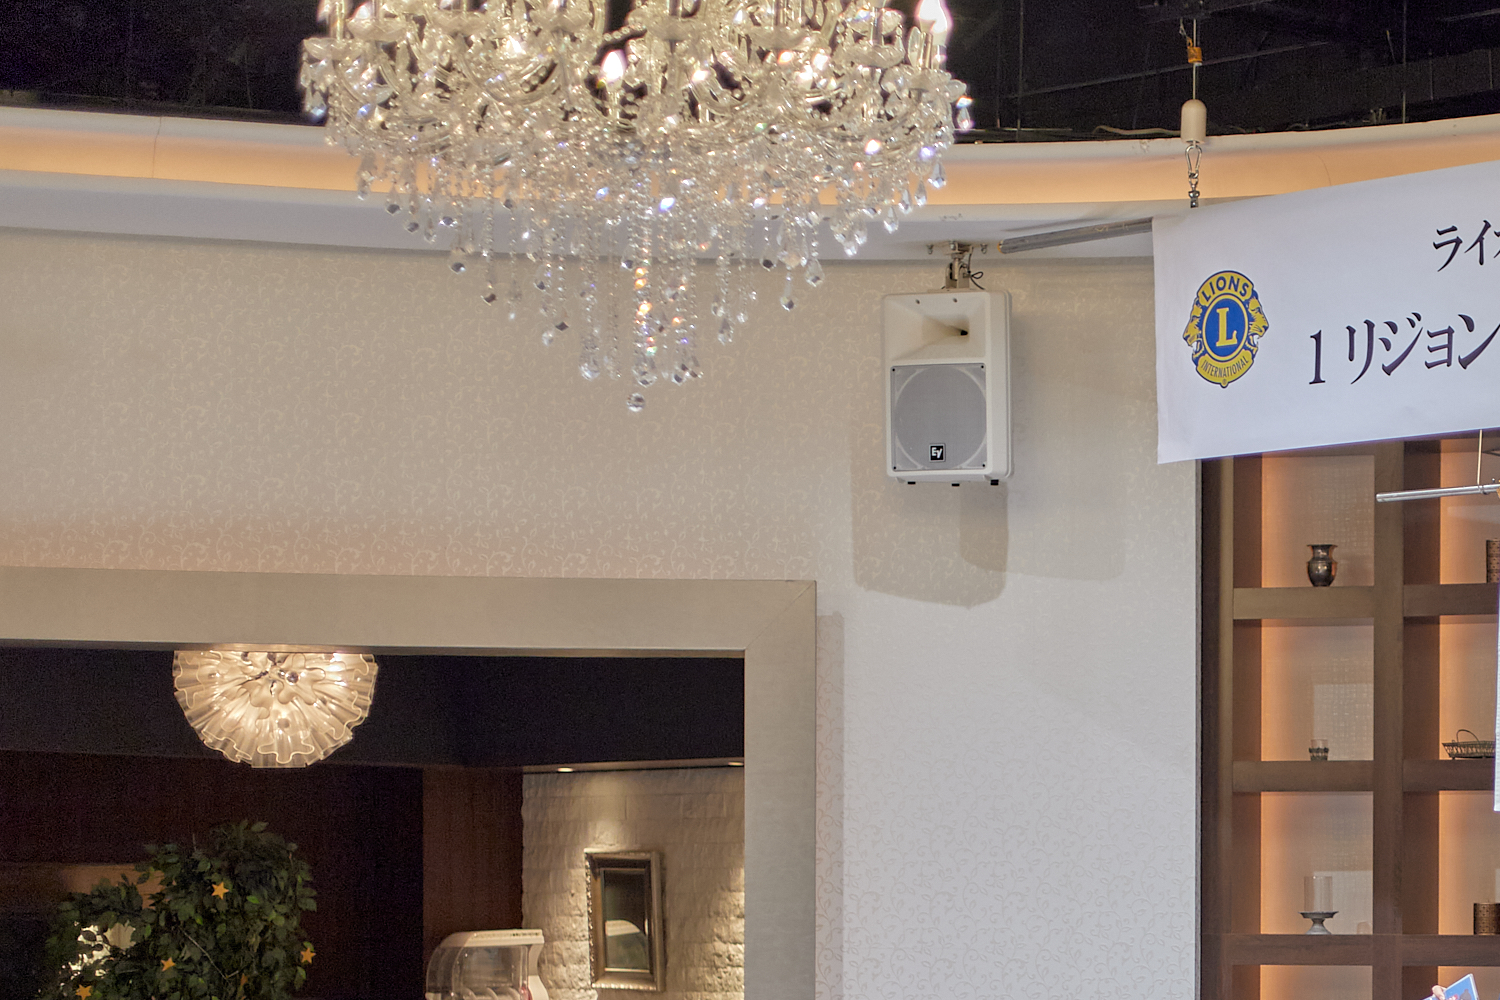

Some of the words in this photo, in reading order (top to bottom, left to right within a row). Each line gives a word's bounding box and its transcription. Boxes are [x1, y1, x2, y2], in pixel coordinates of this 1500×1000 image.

[1201, 276, 1250, 302] LIONS
[1216, 307, 1237, 346] L
[1200, 355, 1249, 378] INTERNATIONAL
